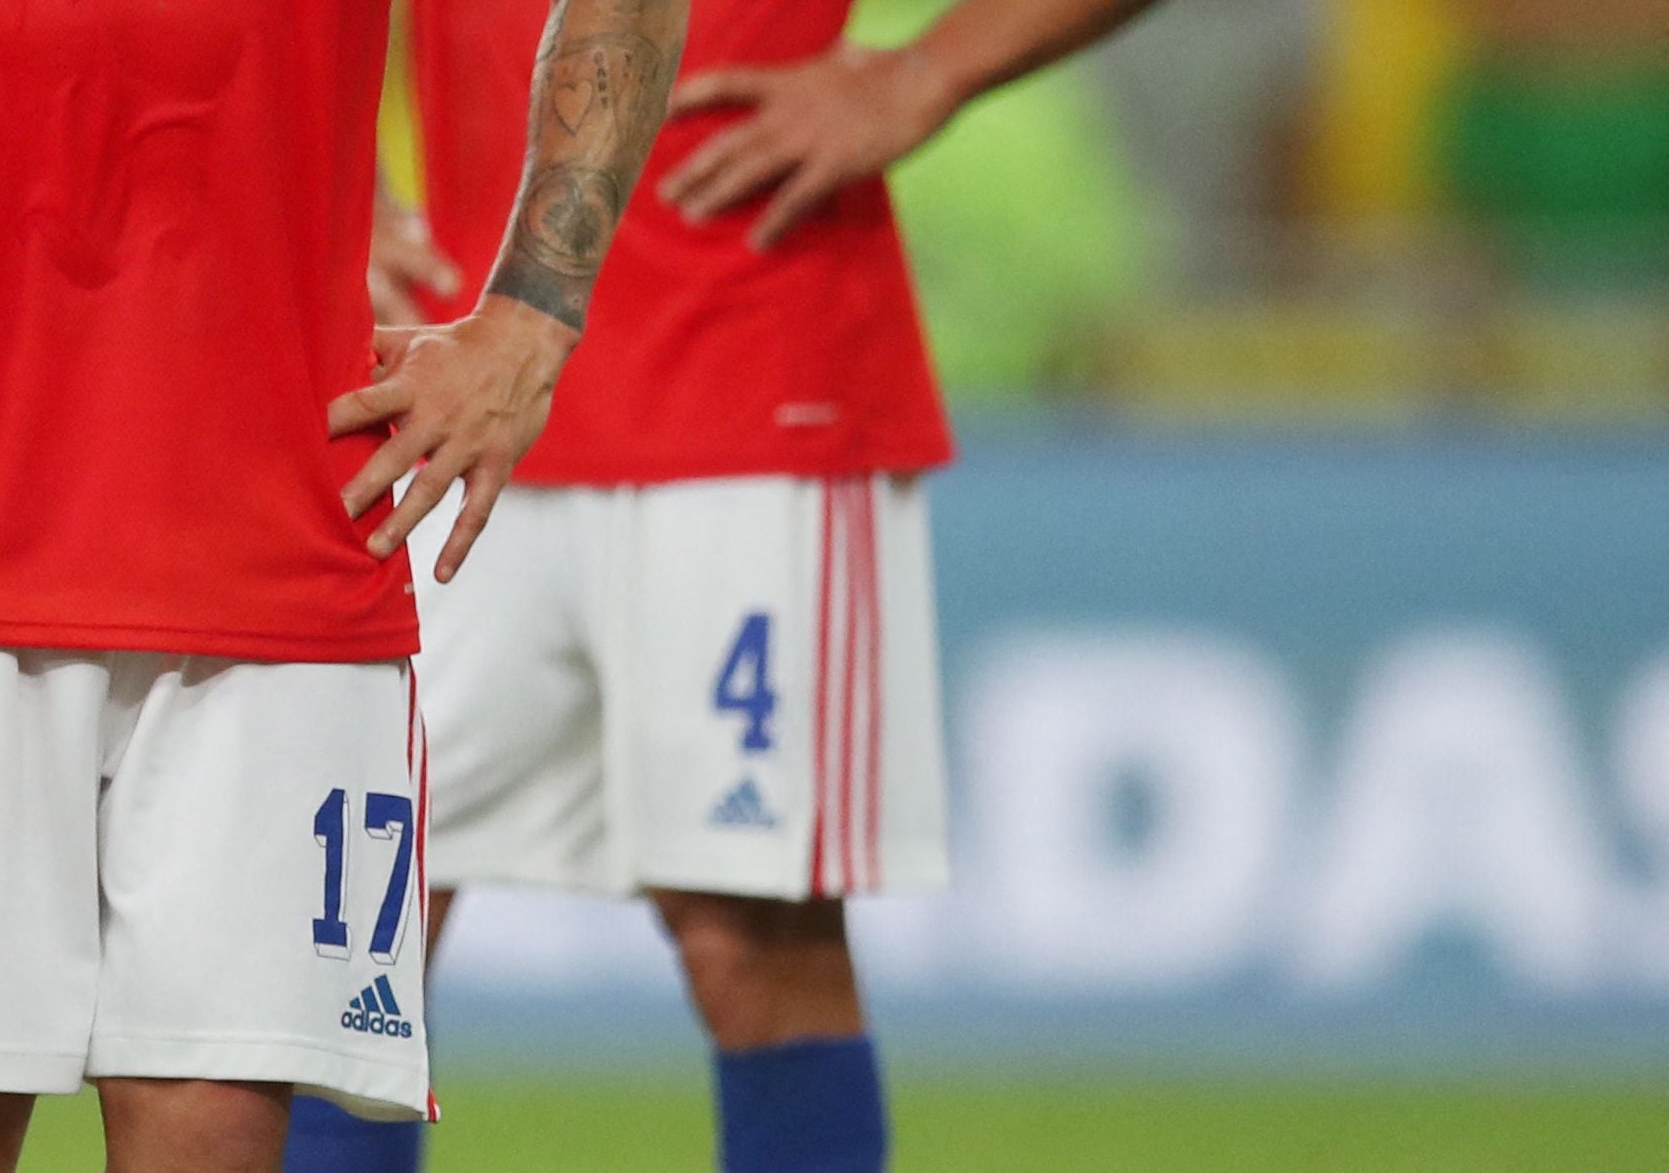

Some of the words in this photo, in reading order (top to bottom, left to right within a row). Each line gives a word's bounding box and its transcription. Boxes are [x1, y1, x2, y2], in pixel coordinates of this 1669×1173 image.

[715, 612, 777, 751] 4
[312, 787, 416, 966] 17
[957, 622, 1669, 992] DA
[340, 1005, 413, 1038] adidas
